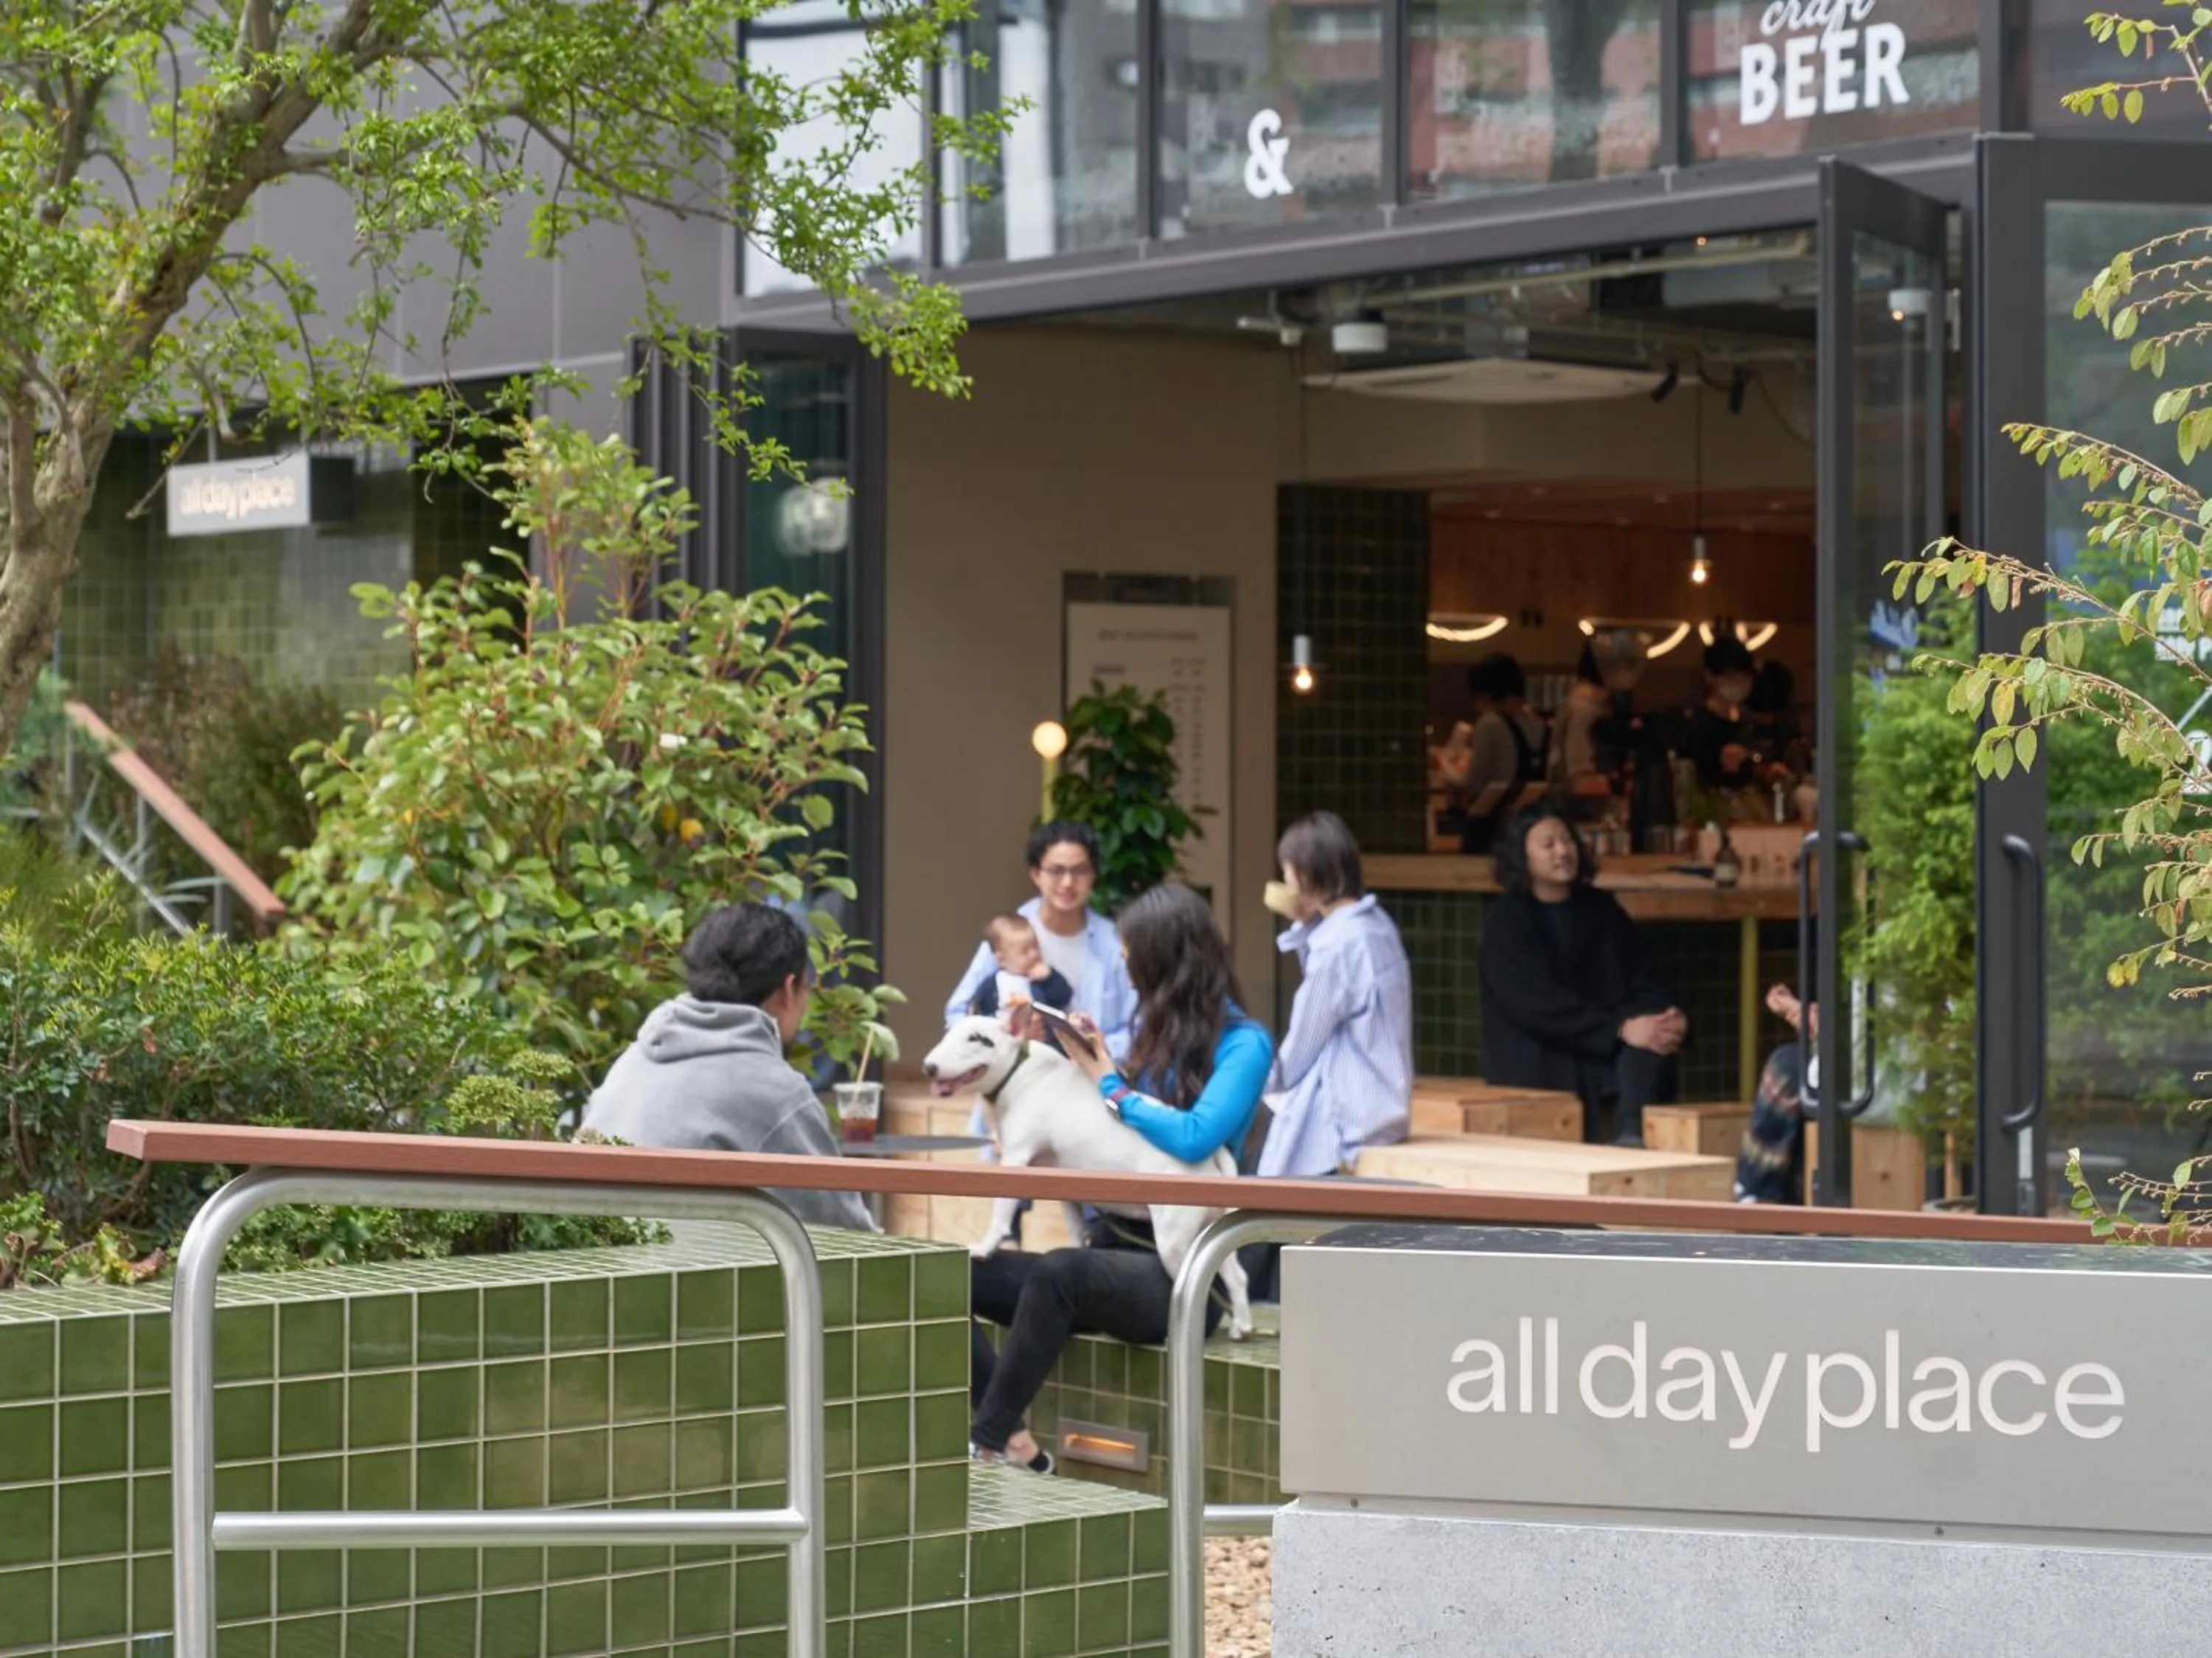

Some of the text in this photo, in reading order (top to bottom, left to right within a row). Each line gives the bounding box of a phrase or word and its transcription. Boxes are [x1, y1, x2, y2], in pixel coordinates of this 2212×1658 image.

[1739, 23, 1910, 125] BEER
[1244, 108, 1293, 199] &
[1447, 1316, 2125, 1453] all day place
